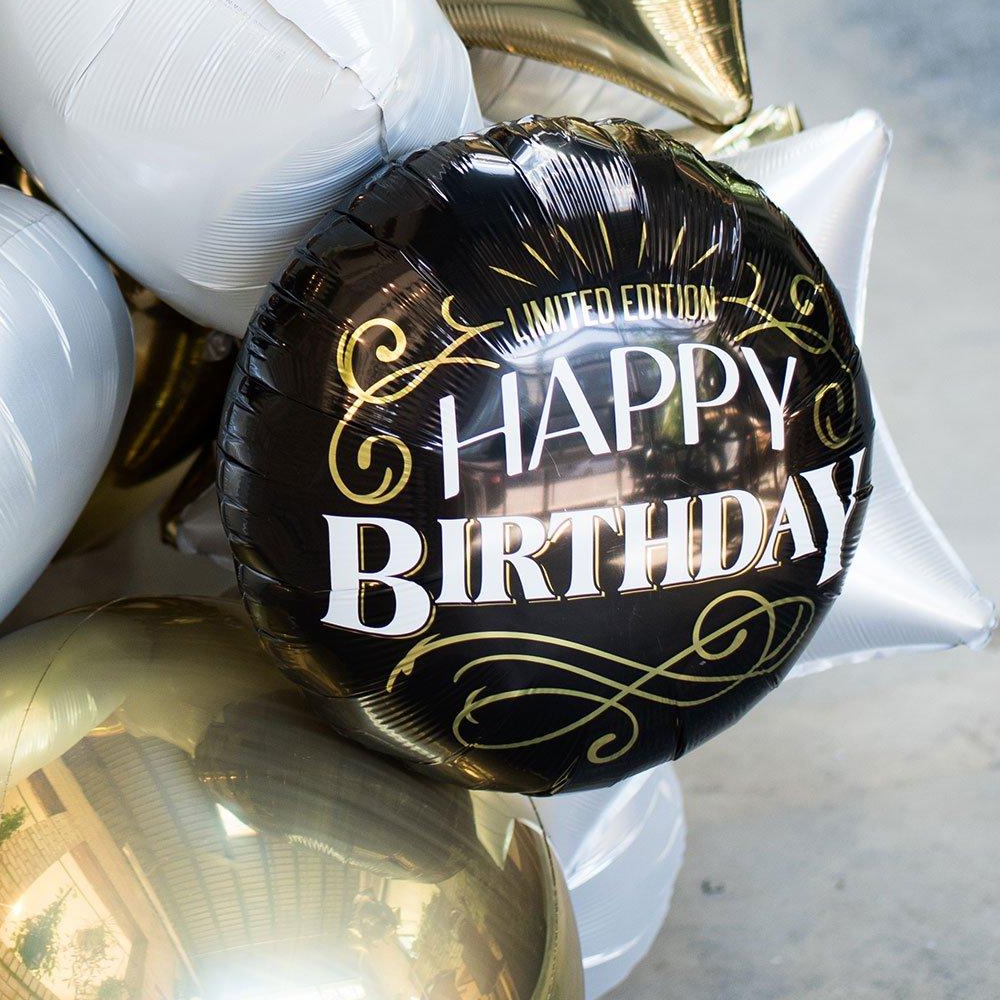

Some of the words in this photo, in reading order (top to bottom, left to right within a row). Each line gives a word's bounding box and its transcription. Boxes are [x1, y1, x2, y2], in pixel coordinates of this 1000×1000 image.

[506, 286, 616, 345] LIMITED
[621, 282, 719, 324] EDITION
[439, 342, 797, 500] HAPPY
[320, 447, 868, 638] BIRTHDAY
